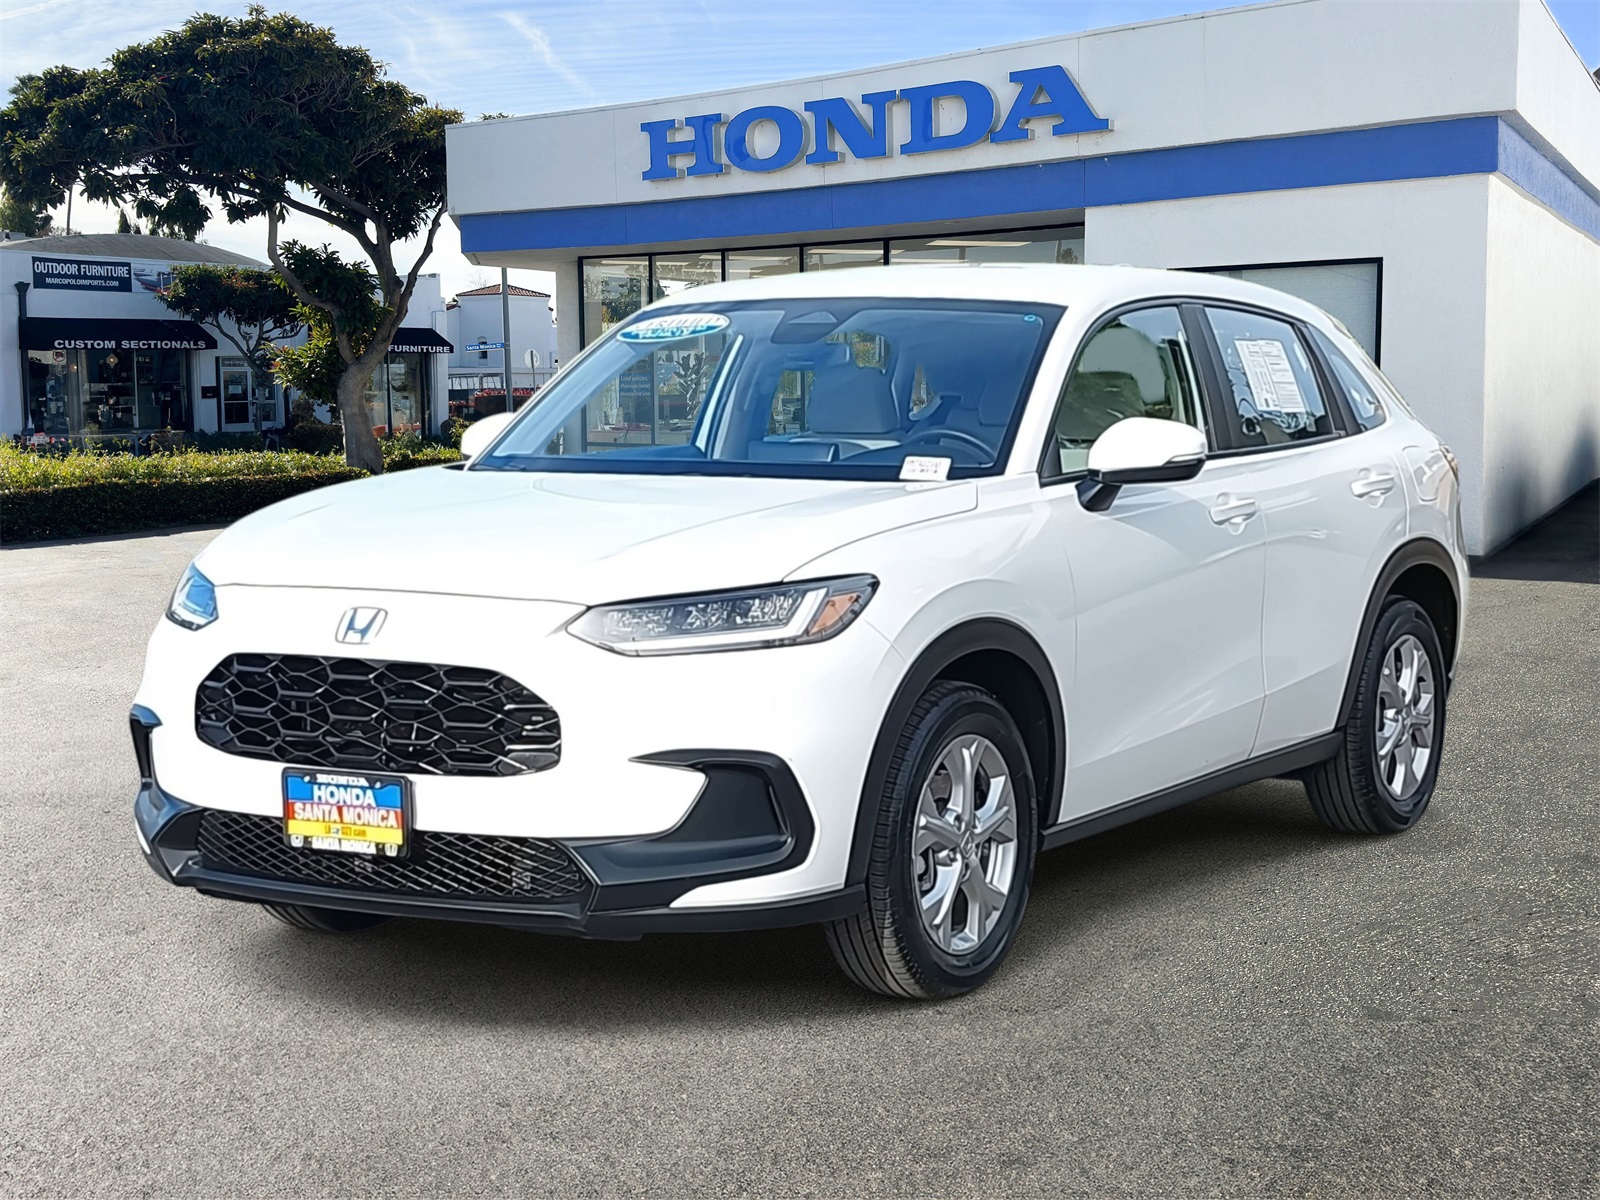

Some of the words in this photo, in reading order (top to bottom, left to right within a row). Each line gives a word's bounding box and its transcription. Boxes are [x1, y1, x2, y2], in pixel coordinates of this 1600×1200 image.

[640, 64, 1114, 182] HONDA
[34, 261, 79, 276] OUTDOOR
[80, 264, 130, 278] FURNITURE
[45, 276, 119, 287] MARCOPOLOIMPORTS.COM
[54, 339, 116, 349] CUSTOM
[121, 340, 206, 349] SECTIONALS
[388, 344, 450, 353] FURNITURE
[312, 784, 377, 807] HONDA
[293, 802, 341, 823] SANTA
[341, 806, 398, 828] MONICA
